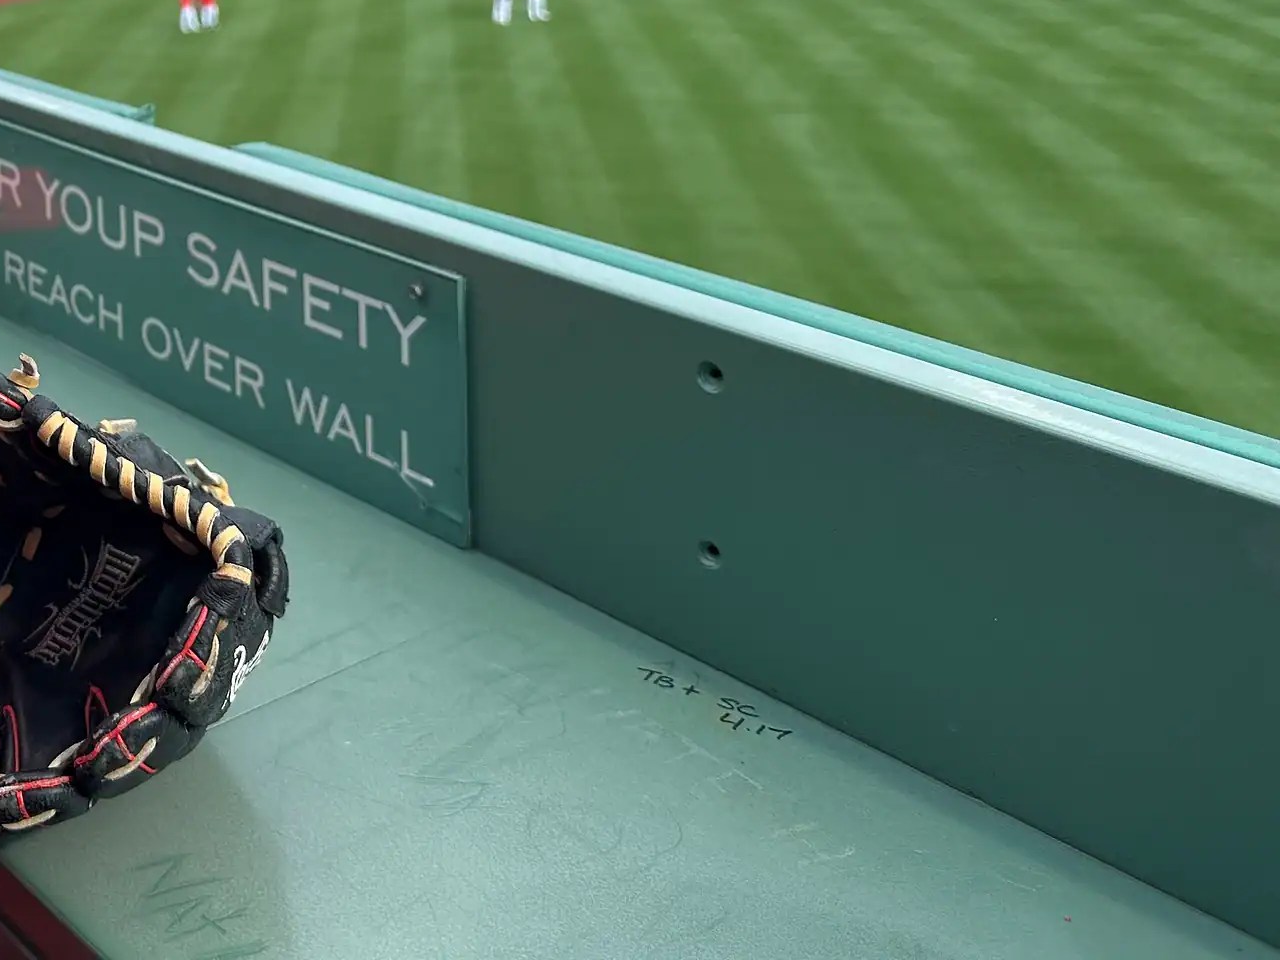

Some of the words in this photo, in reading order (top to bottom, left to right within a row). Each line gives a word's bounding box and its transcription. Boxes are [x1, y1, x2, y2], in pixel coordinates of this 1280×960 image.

[186, 231, 426, 368] SAFETY
[3, 250, 124, 340] REACH
[141, 316, 265, 409] OVER
[286, 378, 435, 488] WALL
[637, 666, 675, 689] TB
[716, 697, 760, 718] SC
[719, 712, 794, 741] 4.17
